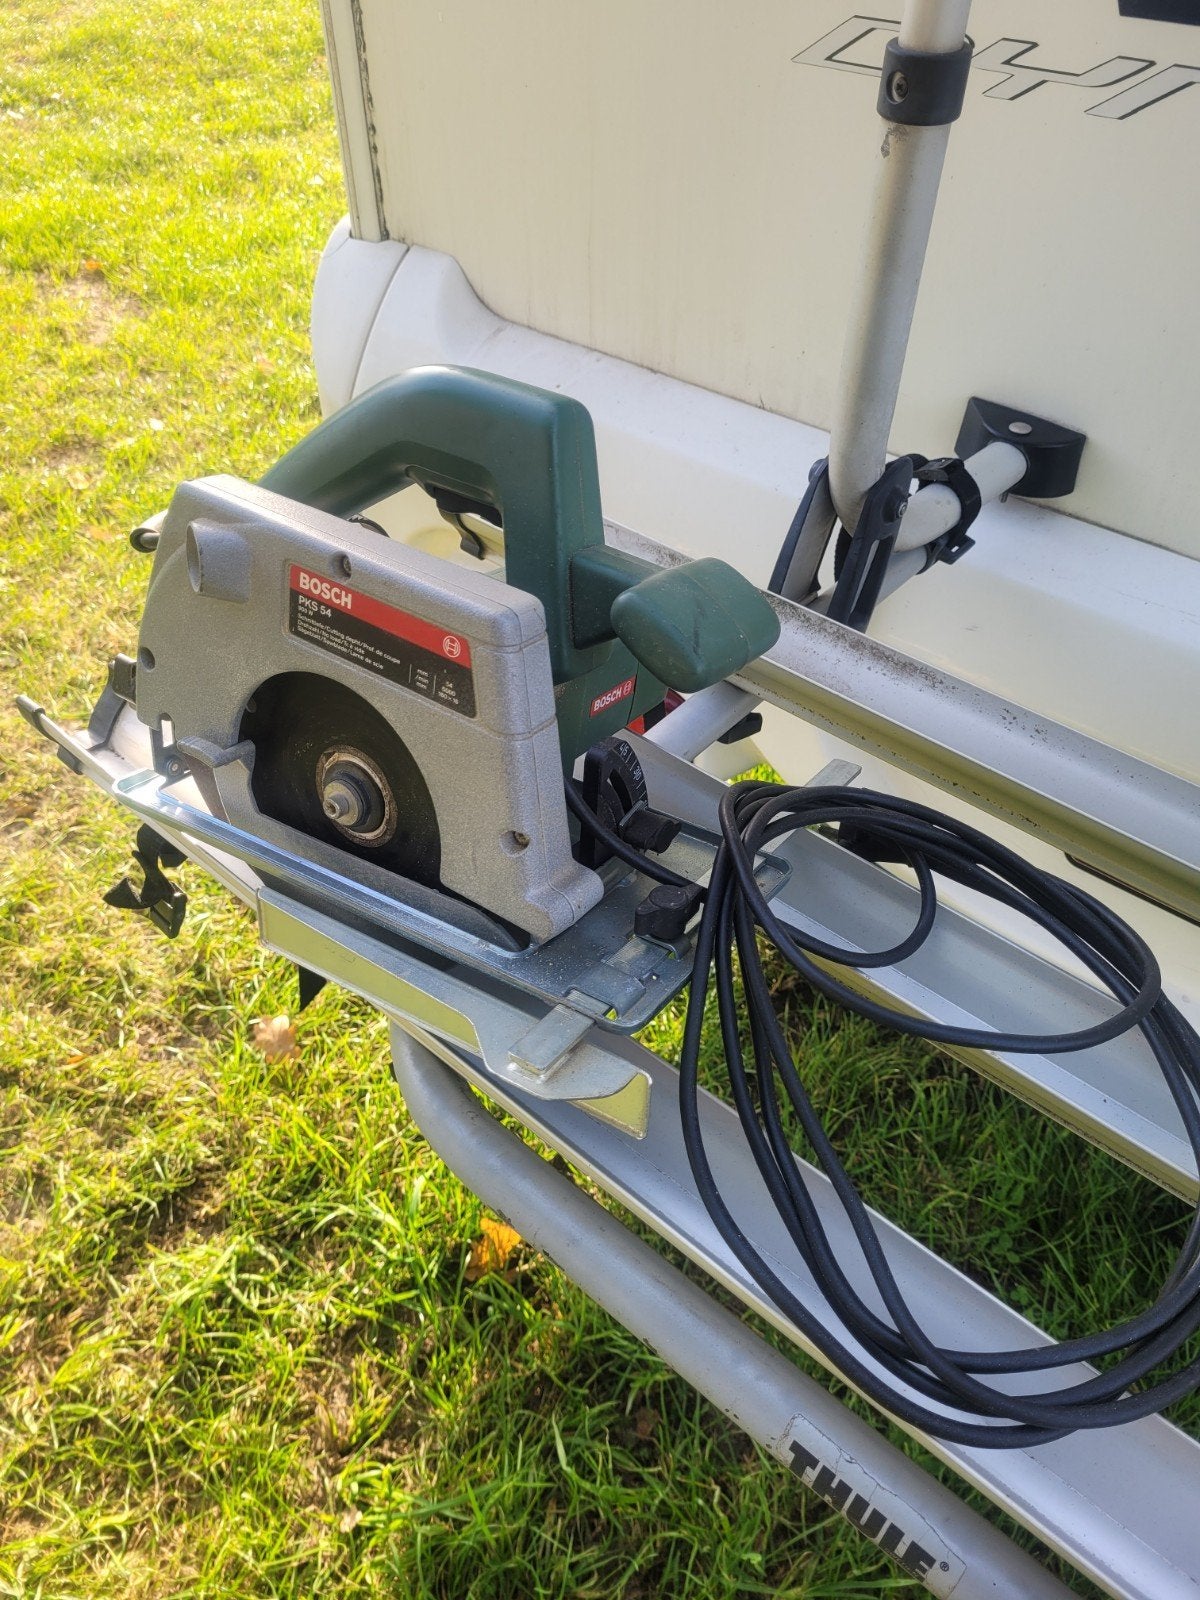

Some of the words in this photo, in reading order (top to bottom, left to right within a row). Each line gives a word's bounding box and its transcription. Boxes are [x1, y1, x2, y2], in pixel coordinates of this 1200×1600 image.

[298, 594, 319, 612] PKS
[320, 605, 332, 618] 54
[299, 571, 353, 610] BOSCH
[593, 686, 623, 712] BOSCH
[788, 1439, 937, 1584] THULE
